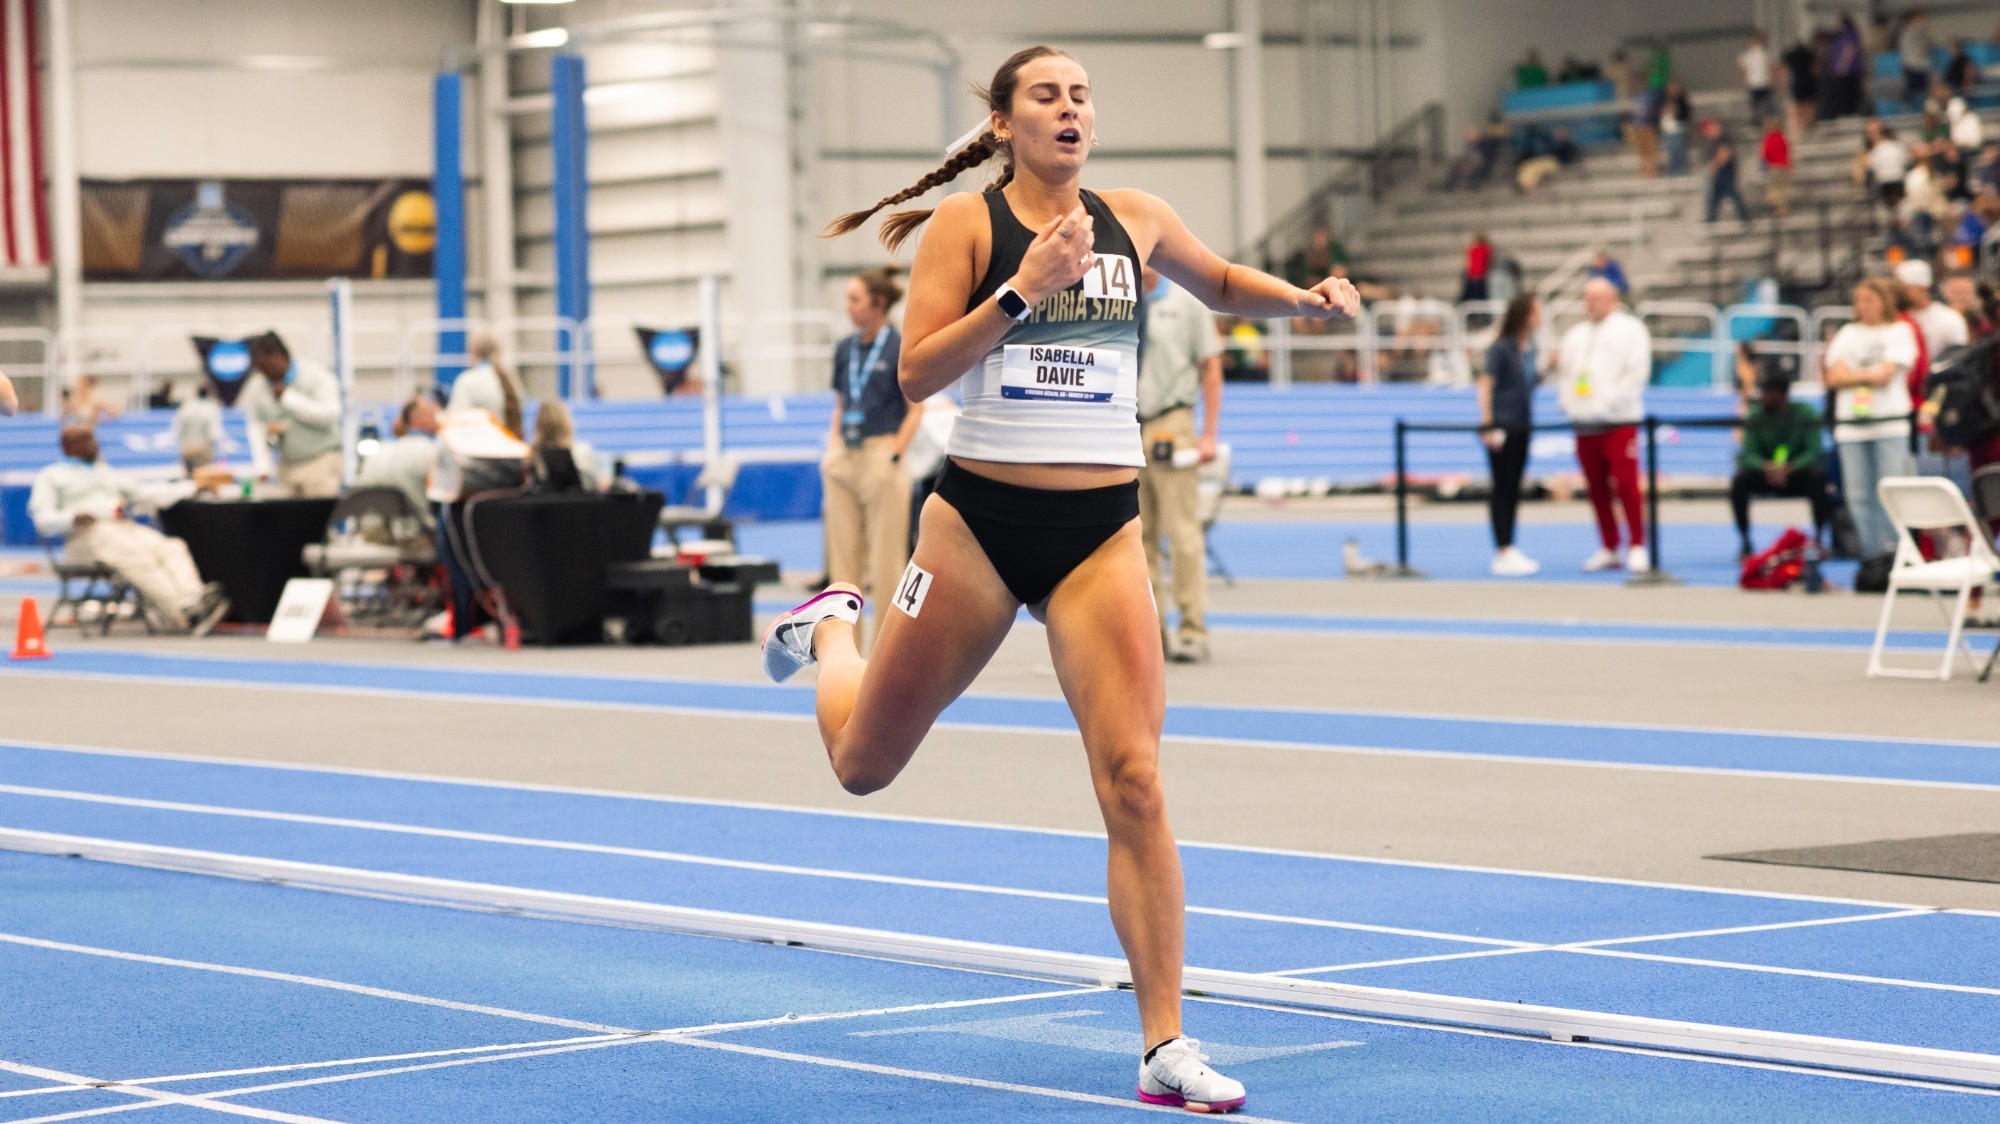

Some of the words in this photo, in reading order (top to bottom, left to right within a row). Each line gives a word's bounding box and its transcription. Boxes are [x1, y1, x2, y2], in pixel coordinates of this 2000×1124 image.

[1094, 257, 1130, 297] 14
[1018, 288, 1087, 325] PORIA
[1030, 347, 1095, 366] ISABELLA
[1036, 366, 1085, 387] DAVIE
[897, 566, 923, 611] 14
